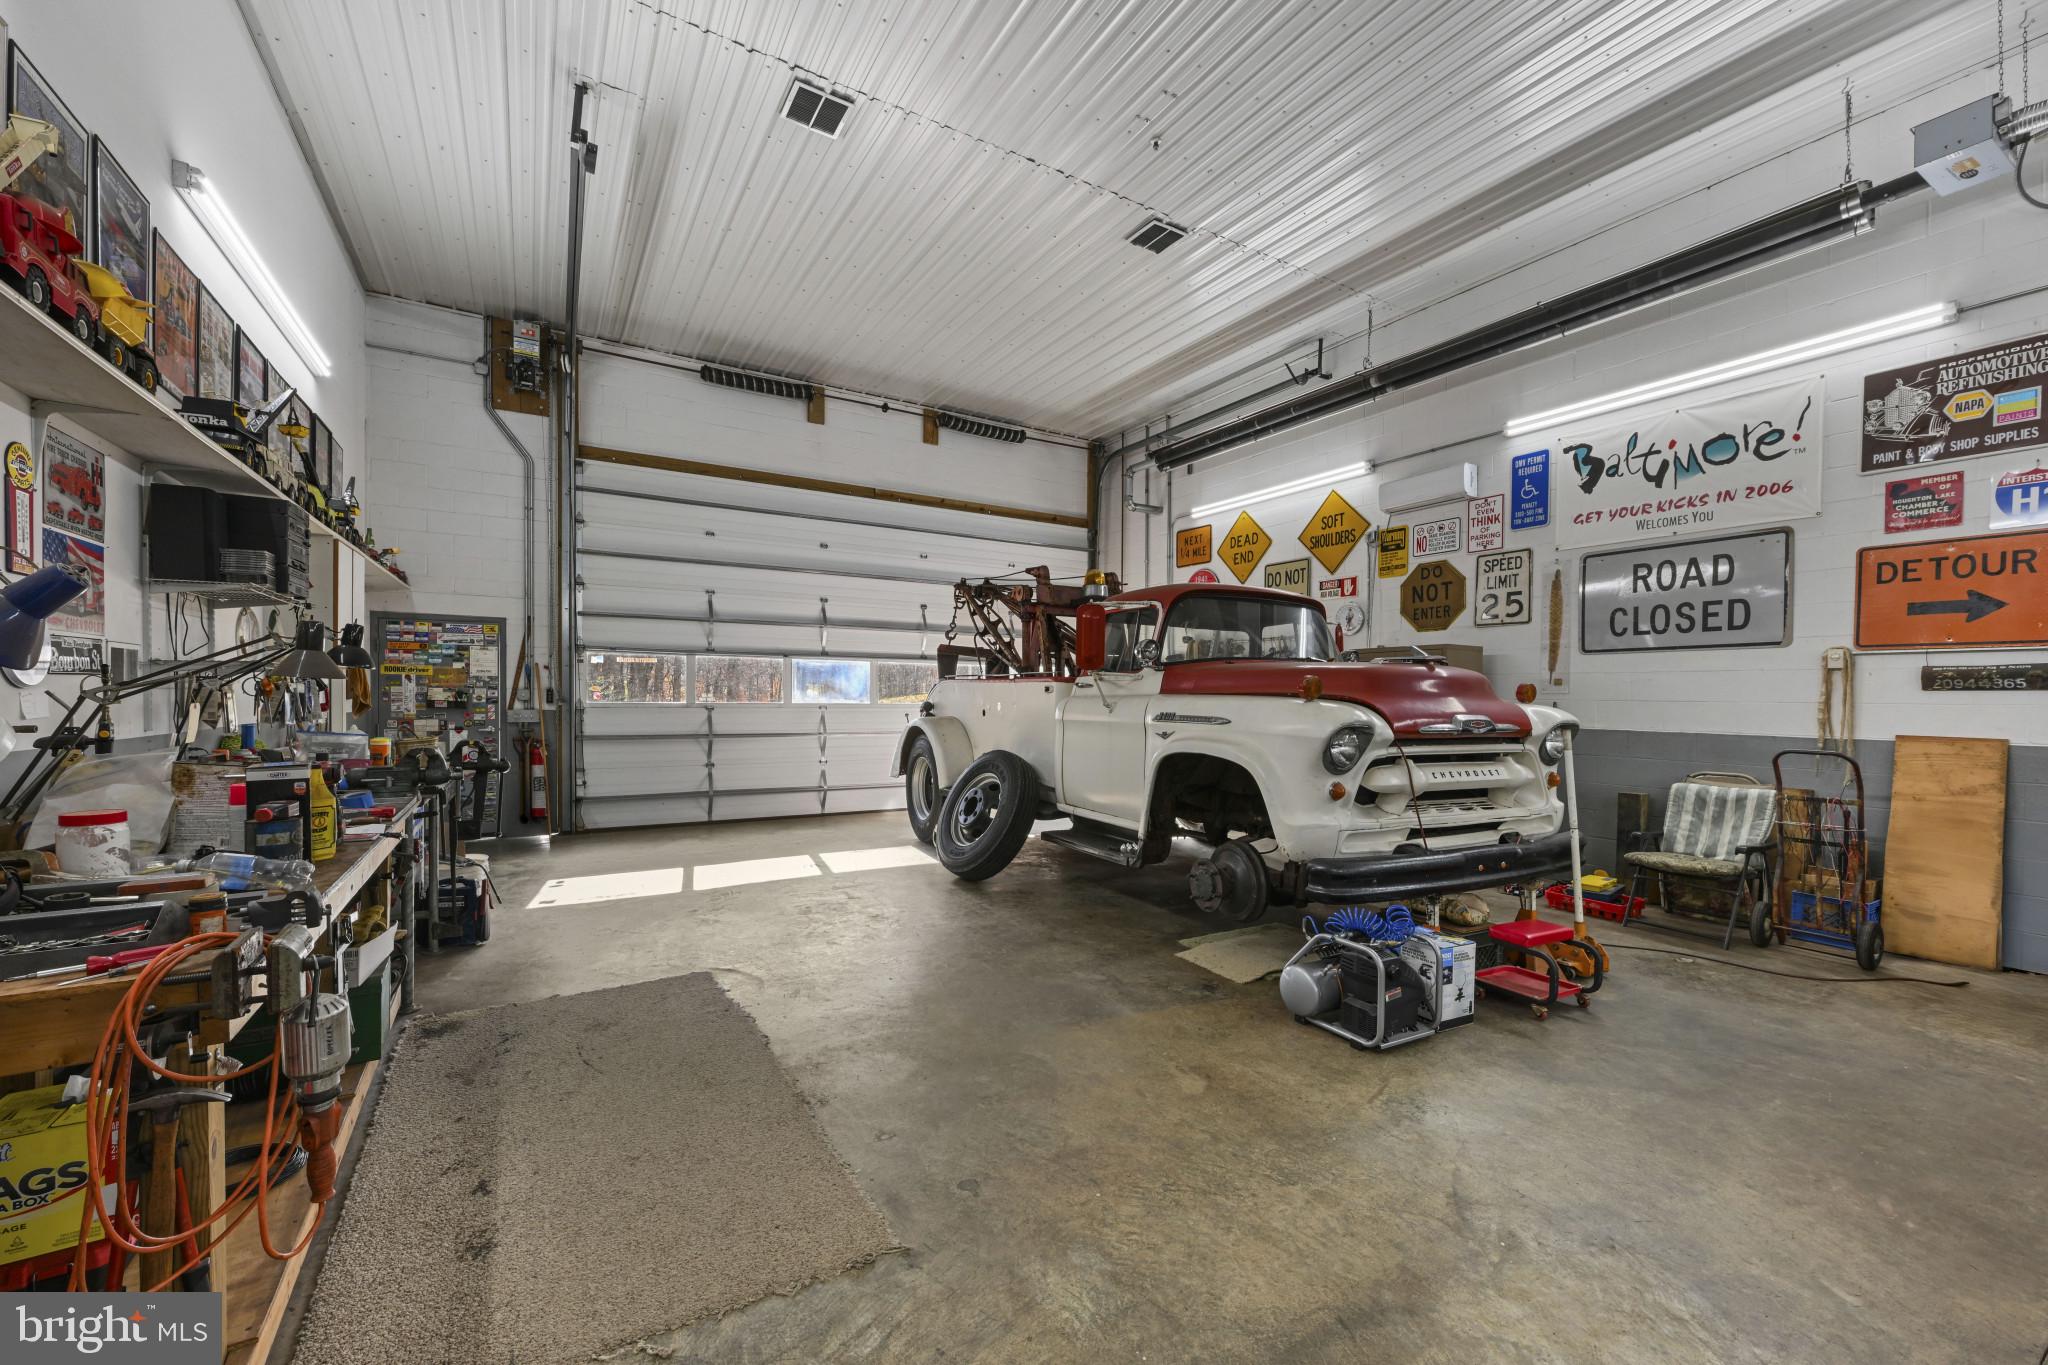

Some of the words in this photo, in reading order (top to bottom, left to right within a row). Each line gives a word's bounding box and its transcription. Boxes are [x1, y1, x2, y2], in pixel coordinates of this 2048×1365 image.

[1937, 347, 2048, 383] AUTOMOTIVE
[1936, 360, 2048, 395] REFINISHING
[1955, 398, 1985, 414] NAPA
[178, 411, 228, 426] Tonka
[2000, 409, 2035, 423] PAINTS
[1873, 448, 1901, 465] PAINT
[1905, 448, 1914, 459] &
[1918, 442, 1946, 457] BODY
[1950, 437, 1979, 452] SHOP
[1984, 426, 2040, 446] SUPPLIES
[1920, 474, 1959, 486] MEMBER
[1573, 511, 1603, 525] GET
[1608, 502, 1652, 521] YOUR
[1656, 492, 1709, 513] KICKS
[1716, 488, 1738, 504] IN
[1745, 480, 1794, 499] 2006
[1935, 491, 1956, 500] LAKE
[1474, 500, 1497, 510] DON'T
[1476, 507, 1495, 516] EVEN
[1891, 505, 1950, 519] COMMERCE
[1895, 501, 1938, 511] CHAMBER
[1321, 513, 1345, 530] SOFT
[1471, 514, 1501, 528] THINK
[1184, 534, 1203, 546] NEXT
[1230, 532, 1259, 549] DEAD
[1309, 528, 1356, 551] SHOULDERS
[1416, 536, 1427, 553] NO
[1470, 532, 1501, 541] PARKING
[1192, 546, 1207, 557] MILE
[1233, 550, 1254, 565] END
[1420, 565, 1443, 580] DO
[1483, 556, 1523, 574] SPEED
[1632, 553, 1736, 594] ROAD
[1875, 548, 2038, 585] DETOUR
[1267, 572, 1282, 588] DO
[1285, 567, 1307, 586] NOT
[1485, 573, 1520, 591] LIMIT
[1412, 581, 1454, 603] NOT
[1412, 604, 1452, 623] ENTER
[1481, 590, 1525, 620] 25
[1609, 598, 1751, 638] CLOSED
[50, 646, 91, 671] Bourbon
[92, 649, 101, 670] St
[1431, 769, 1500, 779] CHEVROLET
[12, 1195, 50, 1211] BOX
